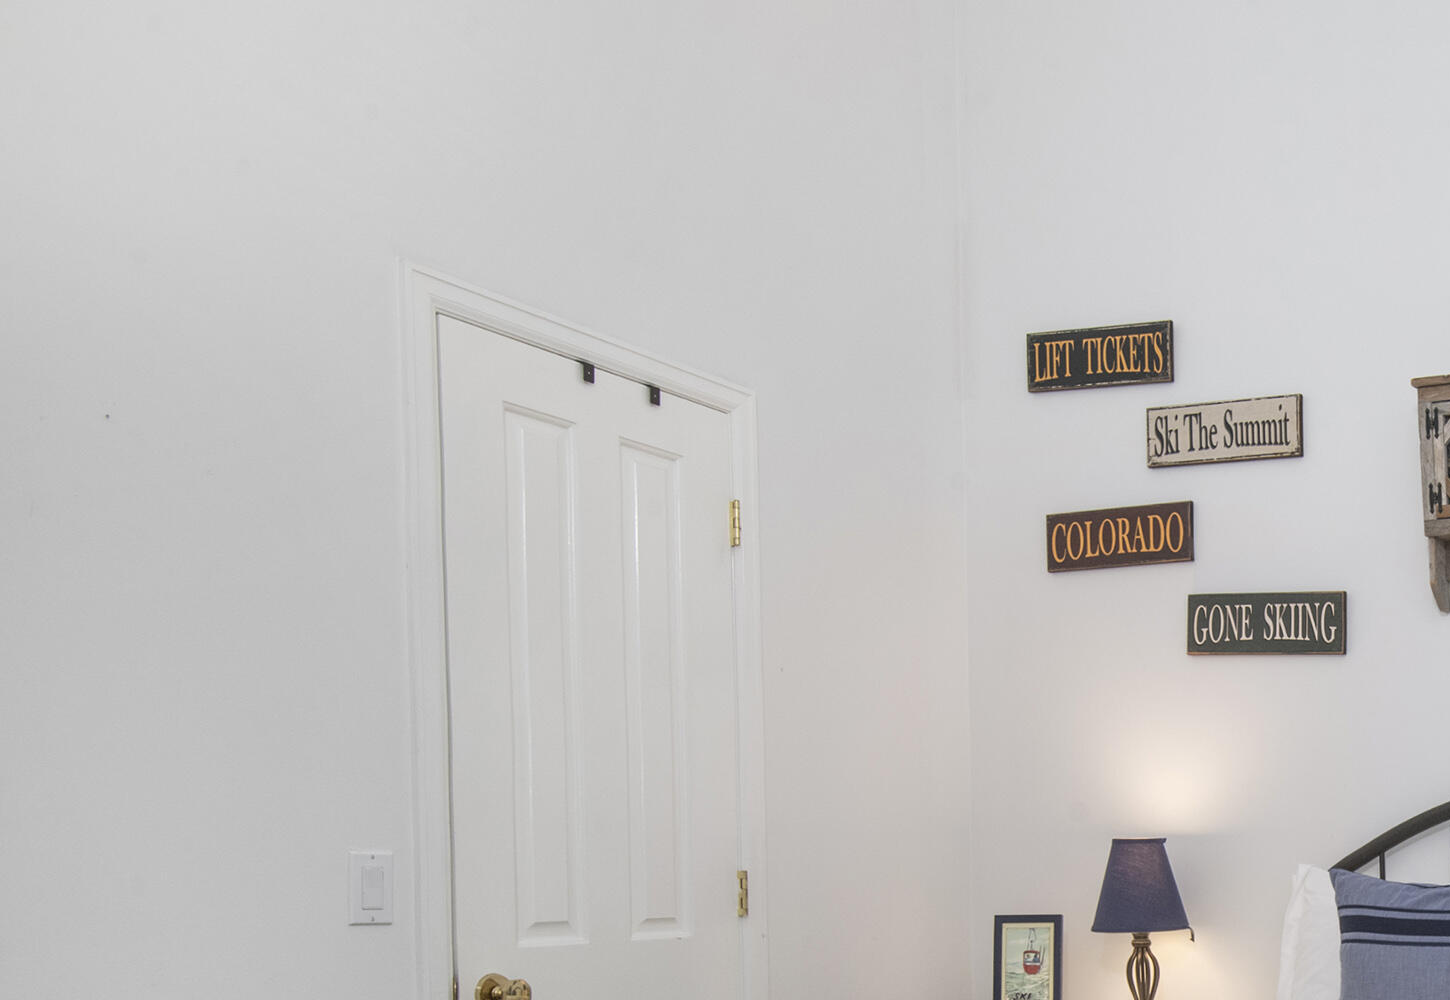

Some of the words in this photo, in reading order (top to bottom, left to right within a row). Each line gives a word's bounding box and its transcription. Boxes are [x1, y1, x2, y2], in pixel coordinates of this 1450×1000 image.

[1033, 339, 1075, 383] LIFT
[1083, 331, 1164, 375] TICKETS
[1153, 415, 1180, 458] Ski
[1183, 411, 1219, 453] The
[1223, 403, 1291, 449] Summit
[1051, 511, 1185, 564] COLORADO
[1193, 604, 1254, 646] GONE
[1263, 601, 1337, 644] SKIING
